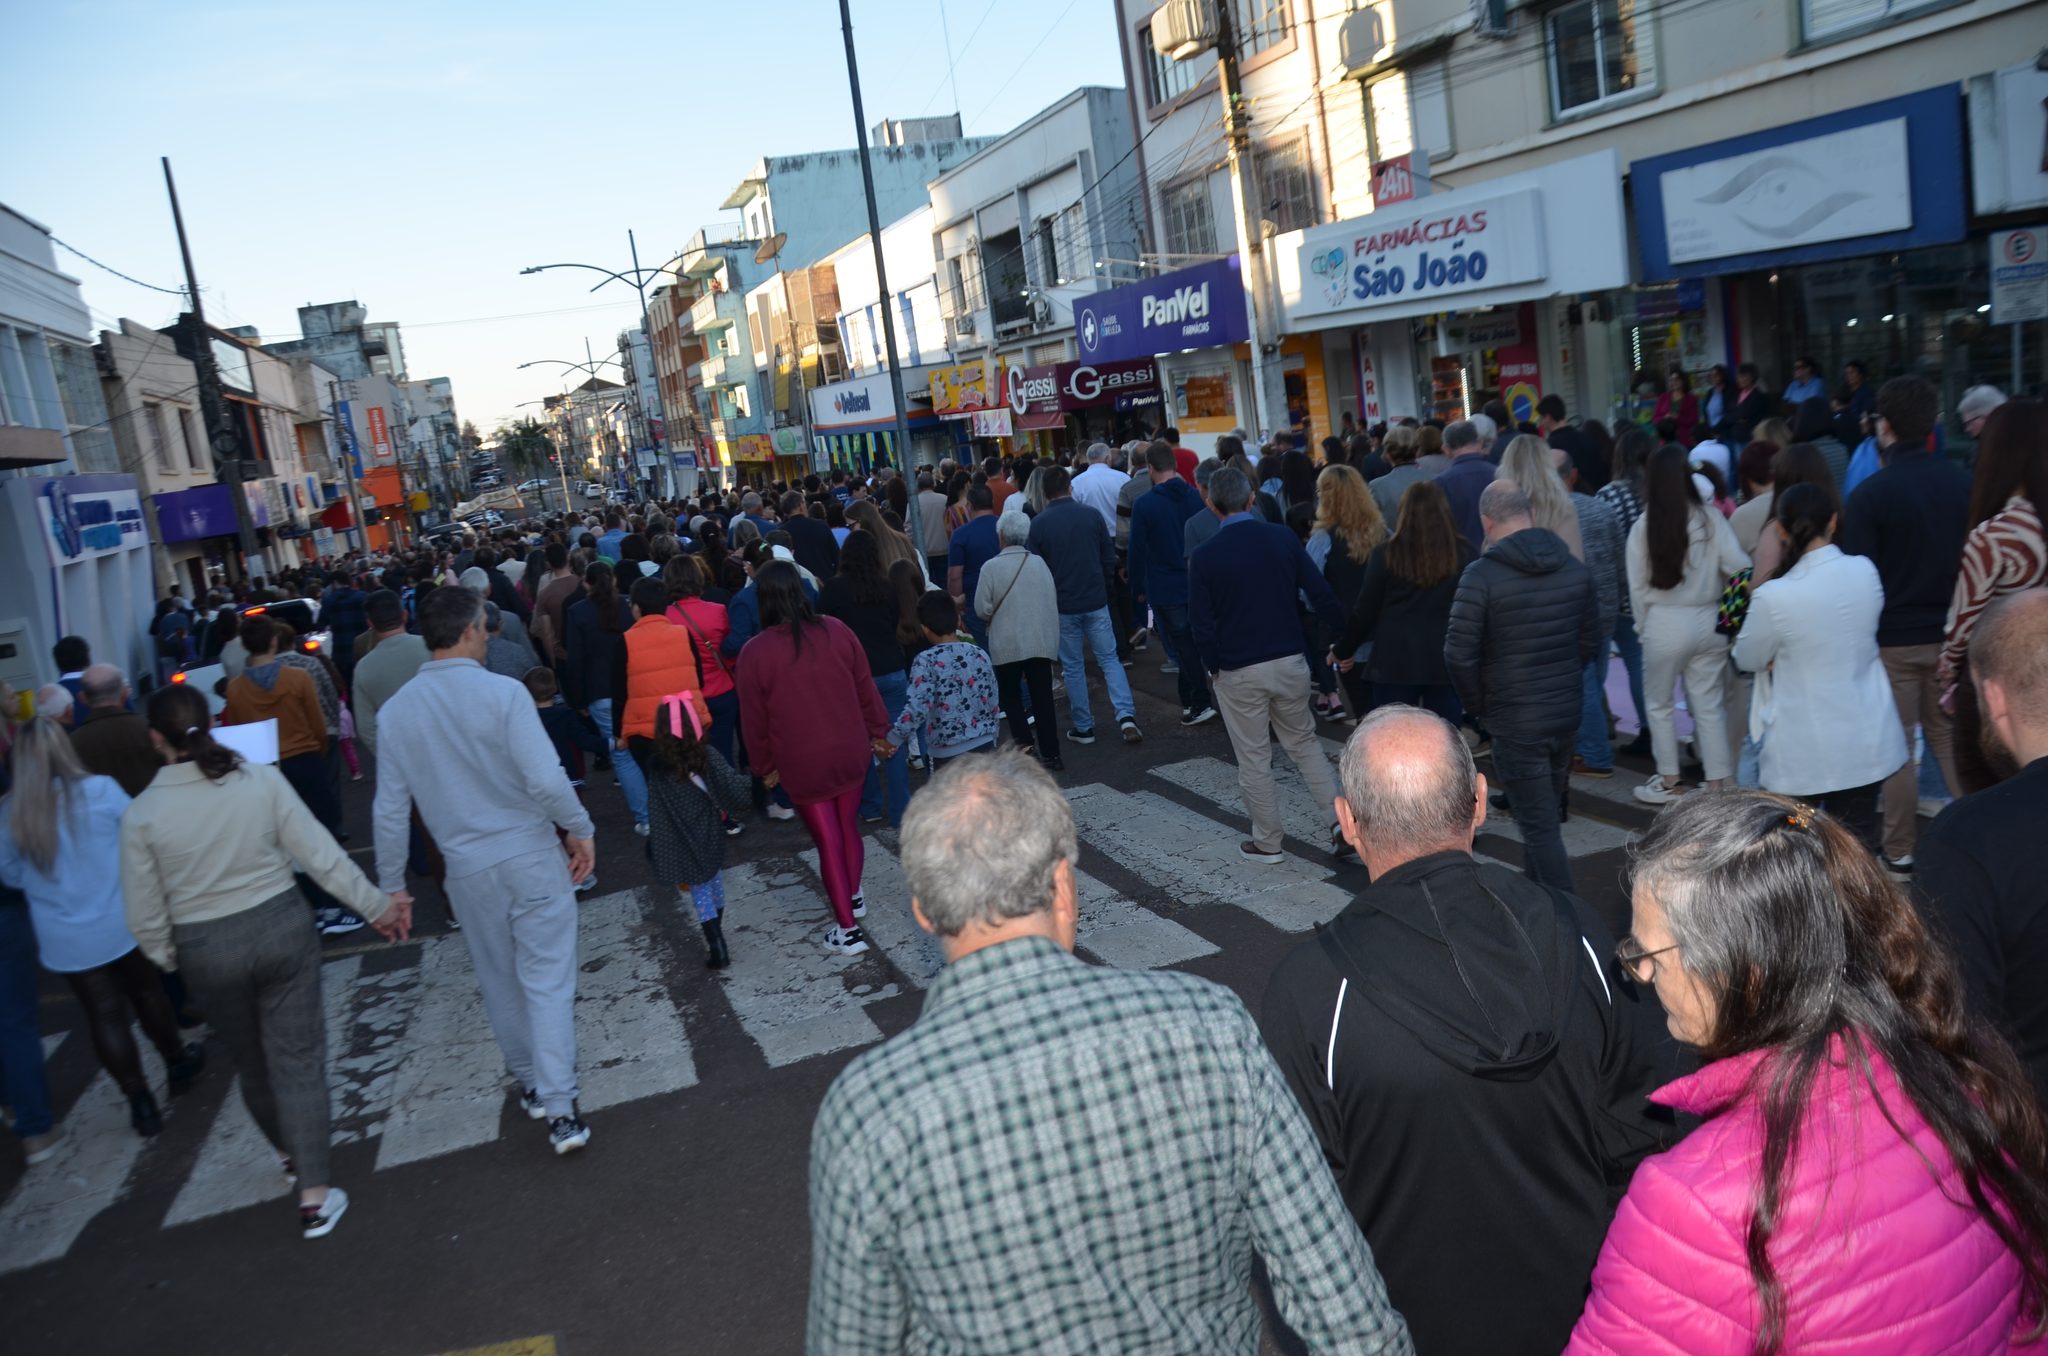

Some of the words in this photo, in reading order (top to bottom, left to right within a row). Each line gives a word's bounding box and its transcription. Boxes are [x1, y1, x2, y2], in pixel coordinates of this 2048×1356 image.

[1376, 162, 1410, 201] 24h
[1354, 210, 1488, 257] FARMÁCIAS
[2013, 235, 2029, 257] E
[1353, 255, 1405, 300] São
[1413, 239, 1488, 290] João
[1102, 311, 1118, 327] SAÚDE
[1142, 281, 1210, 329] PanVel
[1182, 321, 1210, 337] FARMÁCIAS
[1006, 365, 1058, 415] Grassi
[1063, 365, 1154, 400] Grassi
